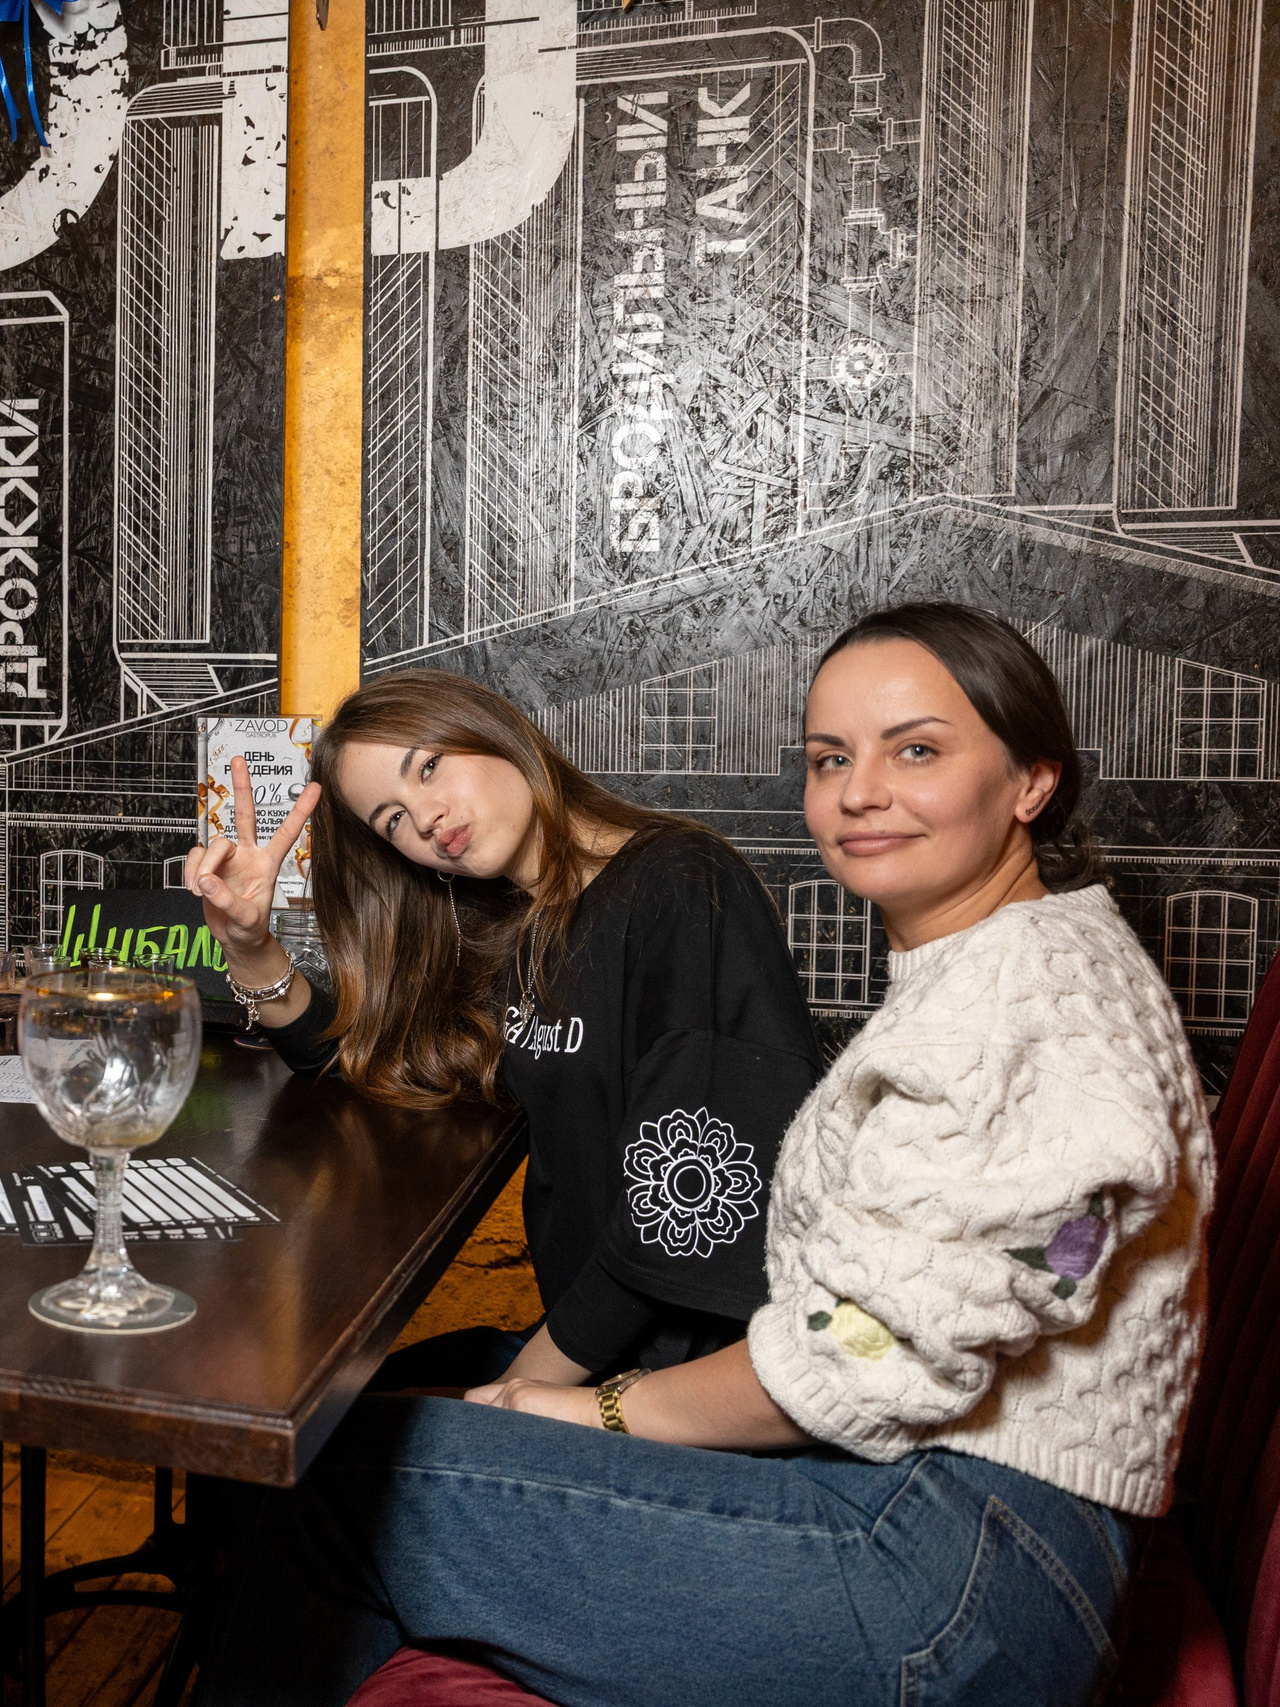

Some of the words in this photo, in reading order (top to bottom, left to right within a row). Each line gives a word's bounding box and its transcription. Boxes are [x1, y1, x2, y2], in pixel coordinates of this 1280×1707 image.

[695, 82, 751, 267] ТАНК
[605, 91, 674, 552] БРОДИЛЬНЫЙ
[235, 719, 289, 732] ZAVOD
[244, 751, 275, 763] ДЕНЬ
[224, 764, 293, 777] РДЕНИЯ
[251, 782, 282, 806] 0%
[564, 1016, 584, 1053] D
